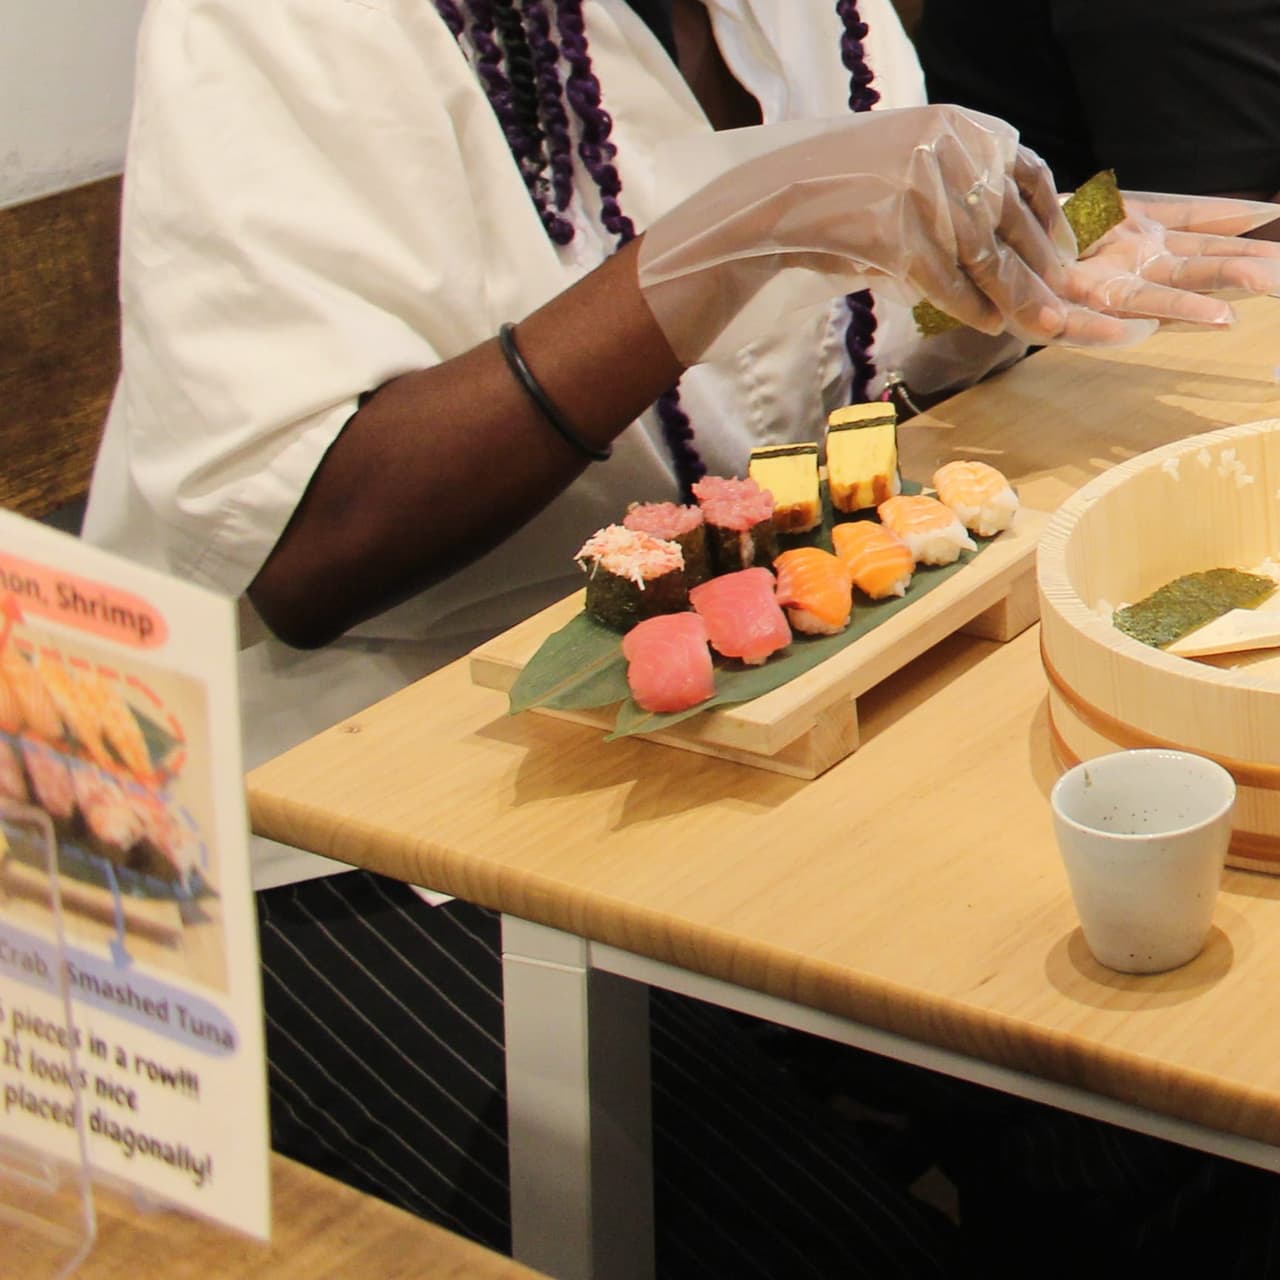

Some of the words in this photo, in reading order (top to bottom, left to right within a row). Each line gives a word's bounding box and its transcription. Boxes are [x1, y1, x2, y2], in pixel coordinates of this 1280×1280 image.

[56, 580, 154, 641] Shrimp
[11, 1008, 81, 1048] pieces
[89, 1028, 107, 1060] in
[115, 1046, 127, 1069] a
[65, 960, 169, 1023] Smashed
[176, 1002, 235, 1051] Tuna
[4, 1037, 21, 1071] It
[95, 1074, 138, 1110] nice
[88, 1107, 213, 1188] diagonally!
